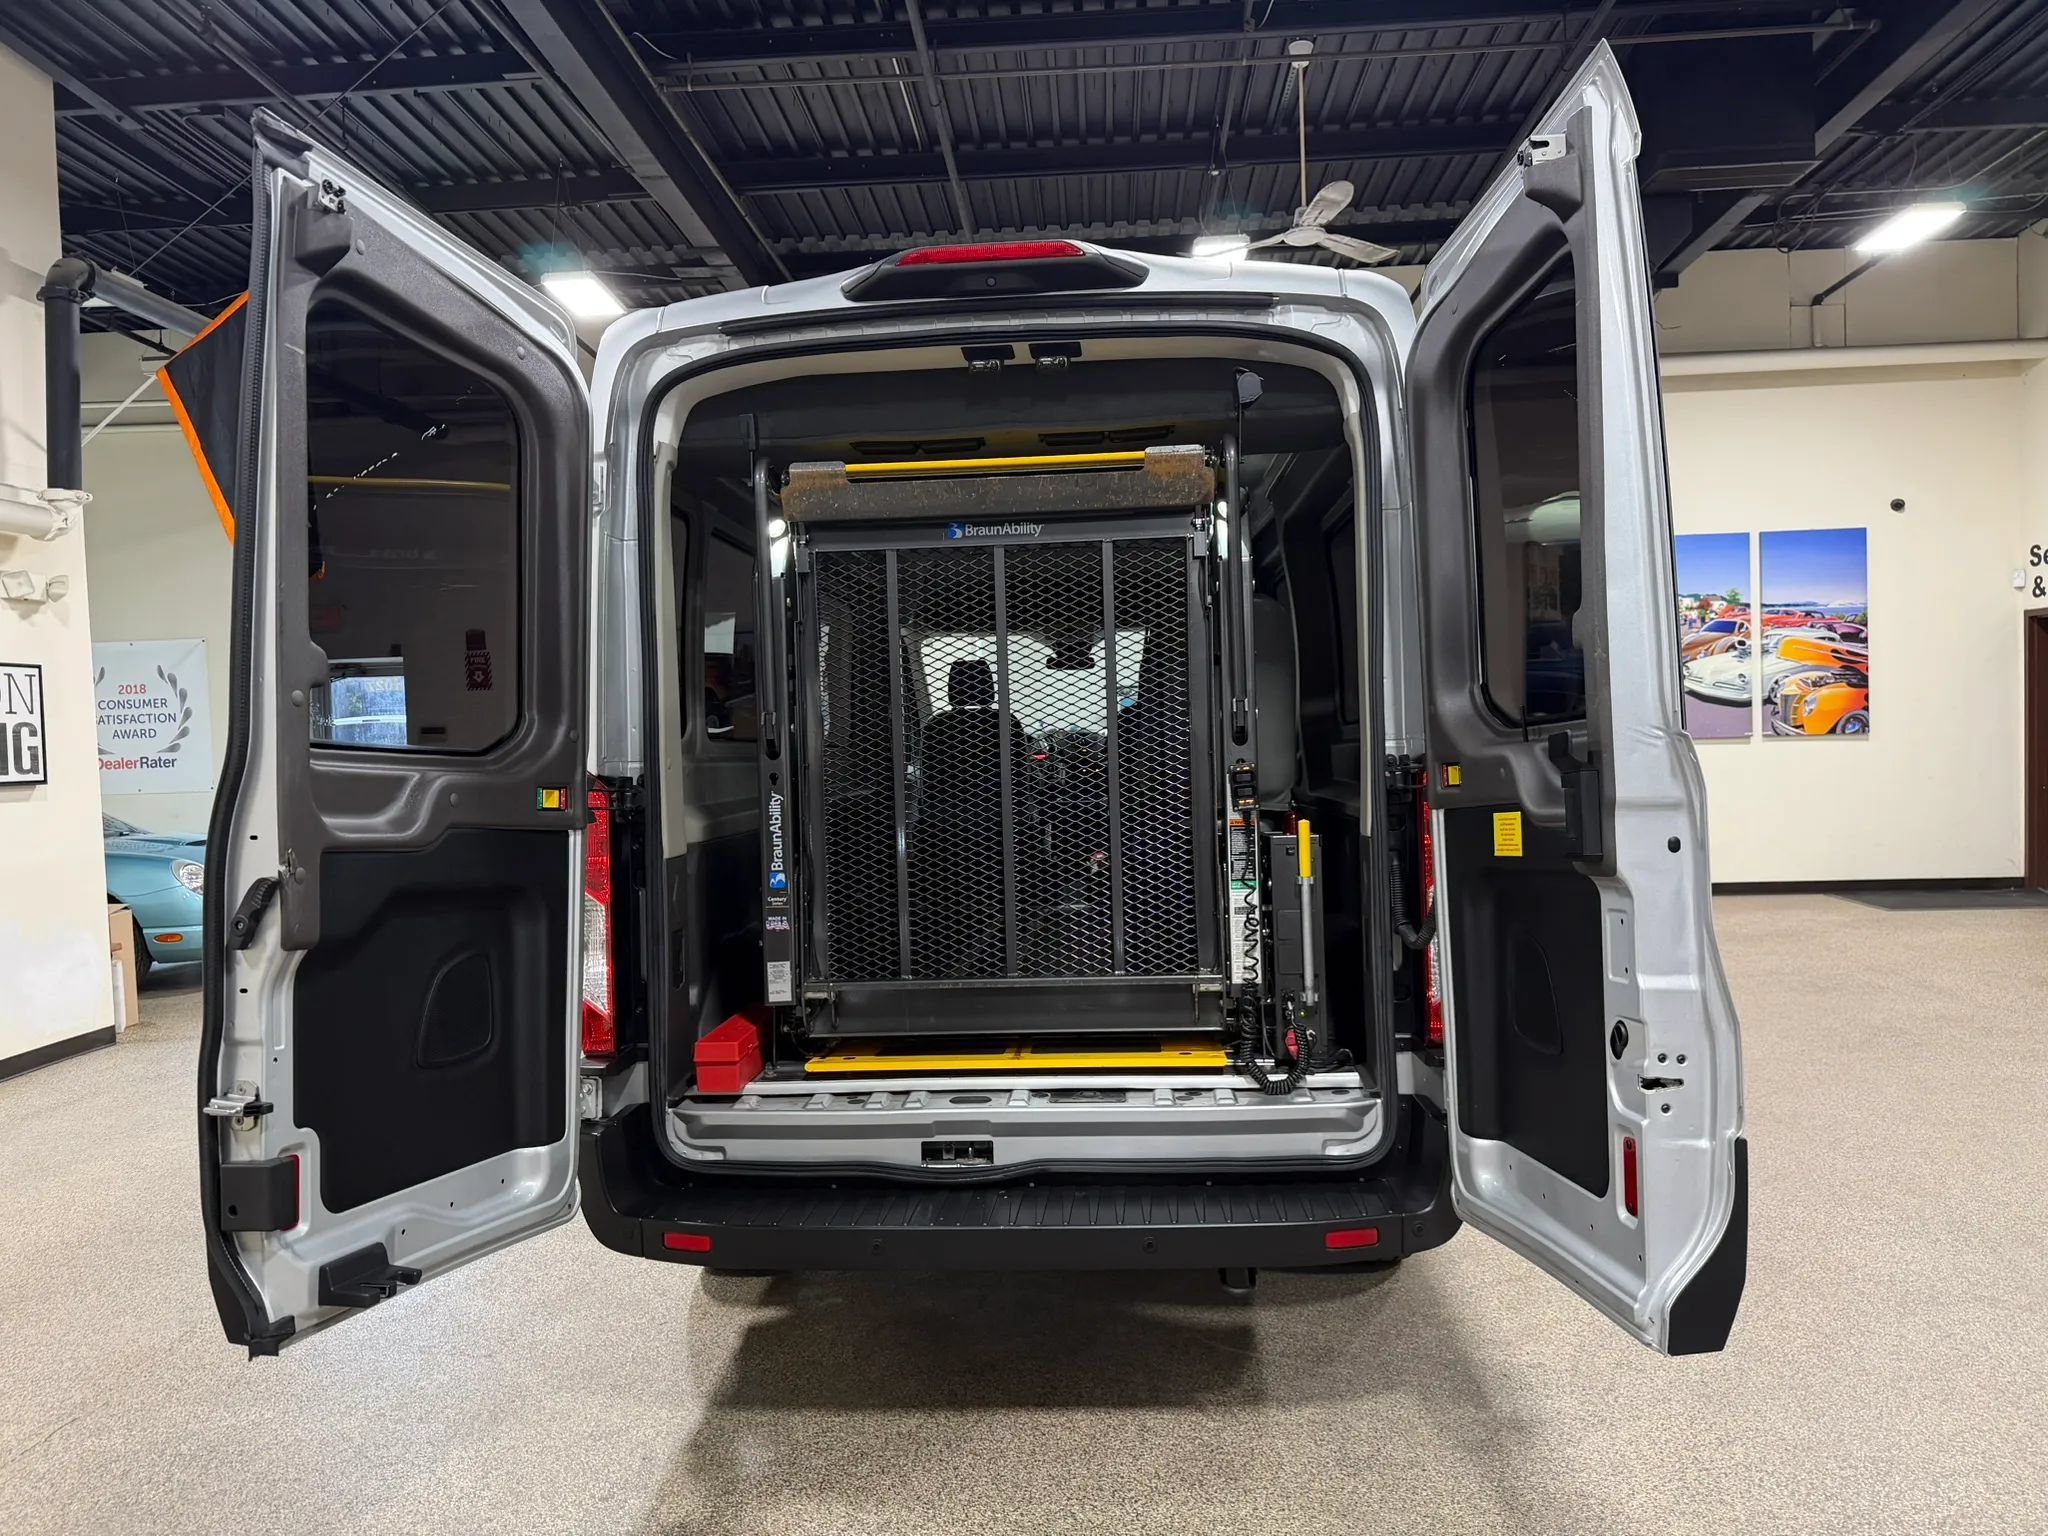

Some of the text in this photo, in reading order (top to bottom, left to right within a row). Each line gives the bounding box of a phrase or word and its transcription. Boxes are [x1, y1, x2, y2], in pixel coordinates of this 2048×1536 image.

[965, 522, 1043, 537] BraunAbility
[2032, 575, 2047, 598] &
[0, 672, 36, 714] N
[117, 684, 147, 695] 2018
[98, 698, 168, 710] CONSUMER
[96, 713, 177, 725] ATISFACTION
[112, 728, 157, 740] AWARD
[769, 792, 784, 871] BraunAbility
